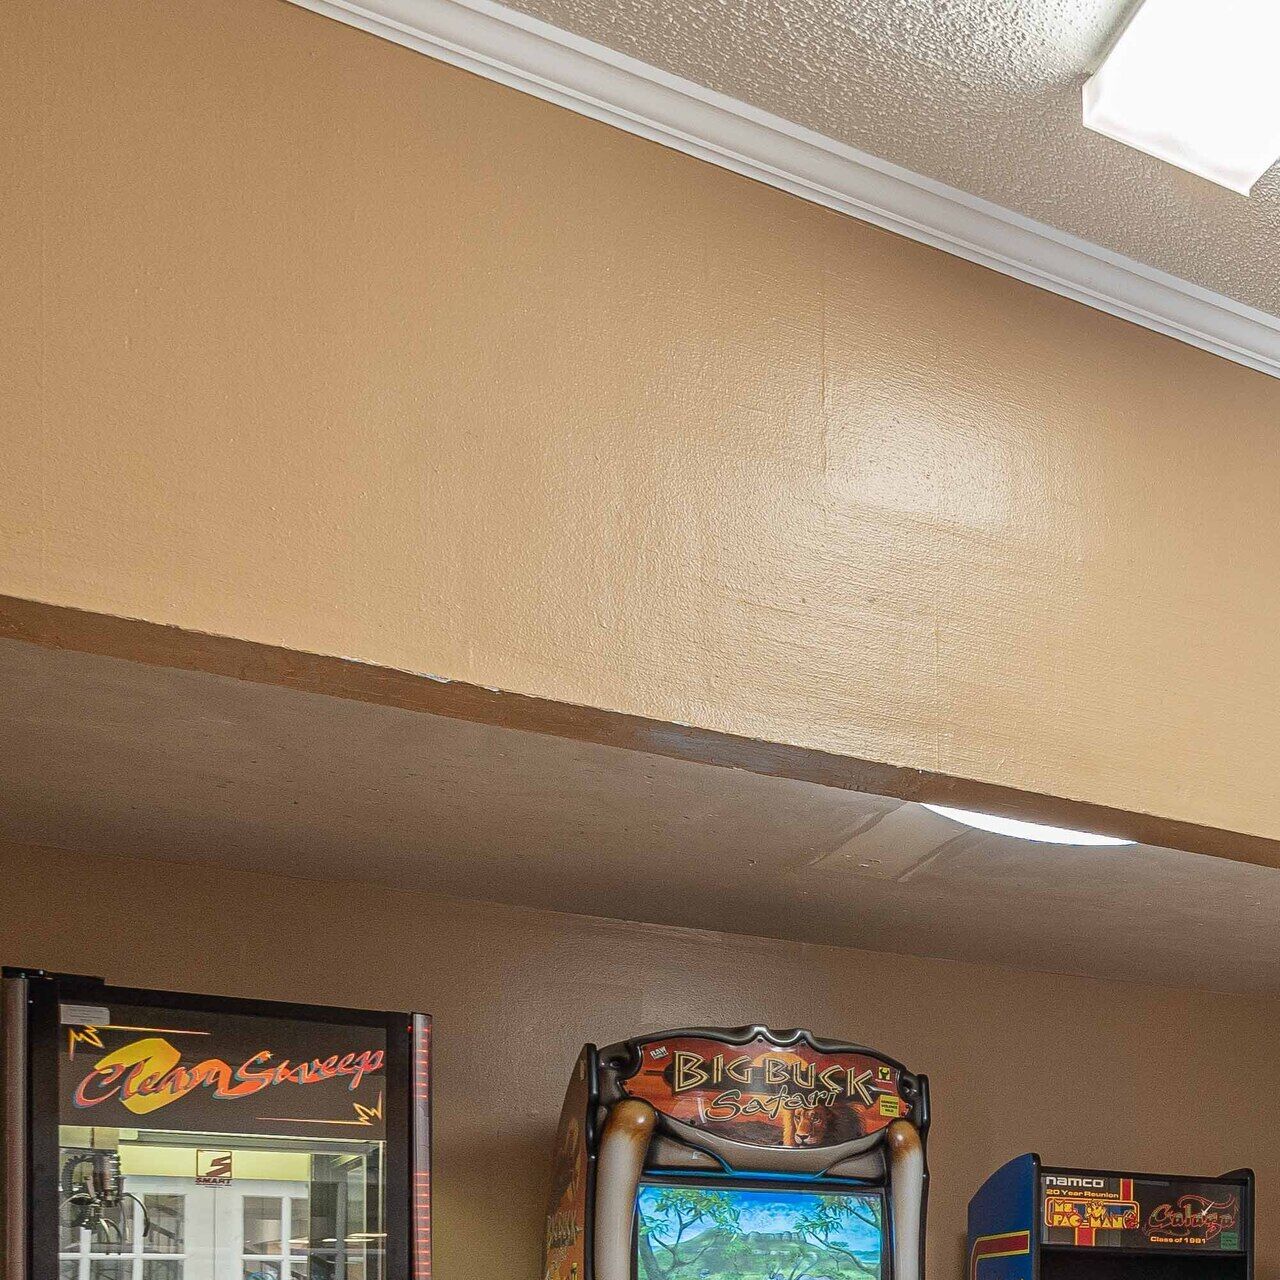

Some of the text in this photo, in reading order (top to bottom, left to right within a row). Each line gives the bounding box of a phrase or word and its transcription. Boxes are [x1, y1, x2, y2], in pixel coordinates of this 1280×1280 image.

[75, 1050, 384, 1109] Clean Sweep
[674, 1051, 875, 1106] BIG BUCK
[705, 1084, 842, 1121] Safari
[1045, 1176, 1105, 1188] namco
[1061, 1189, 1083, 1197] Year
[1084, 1190, 1119, 1199] Reunion
